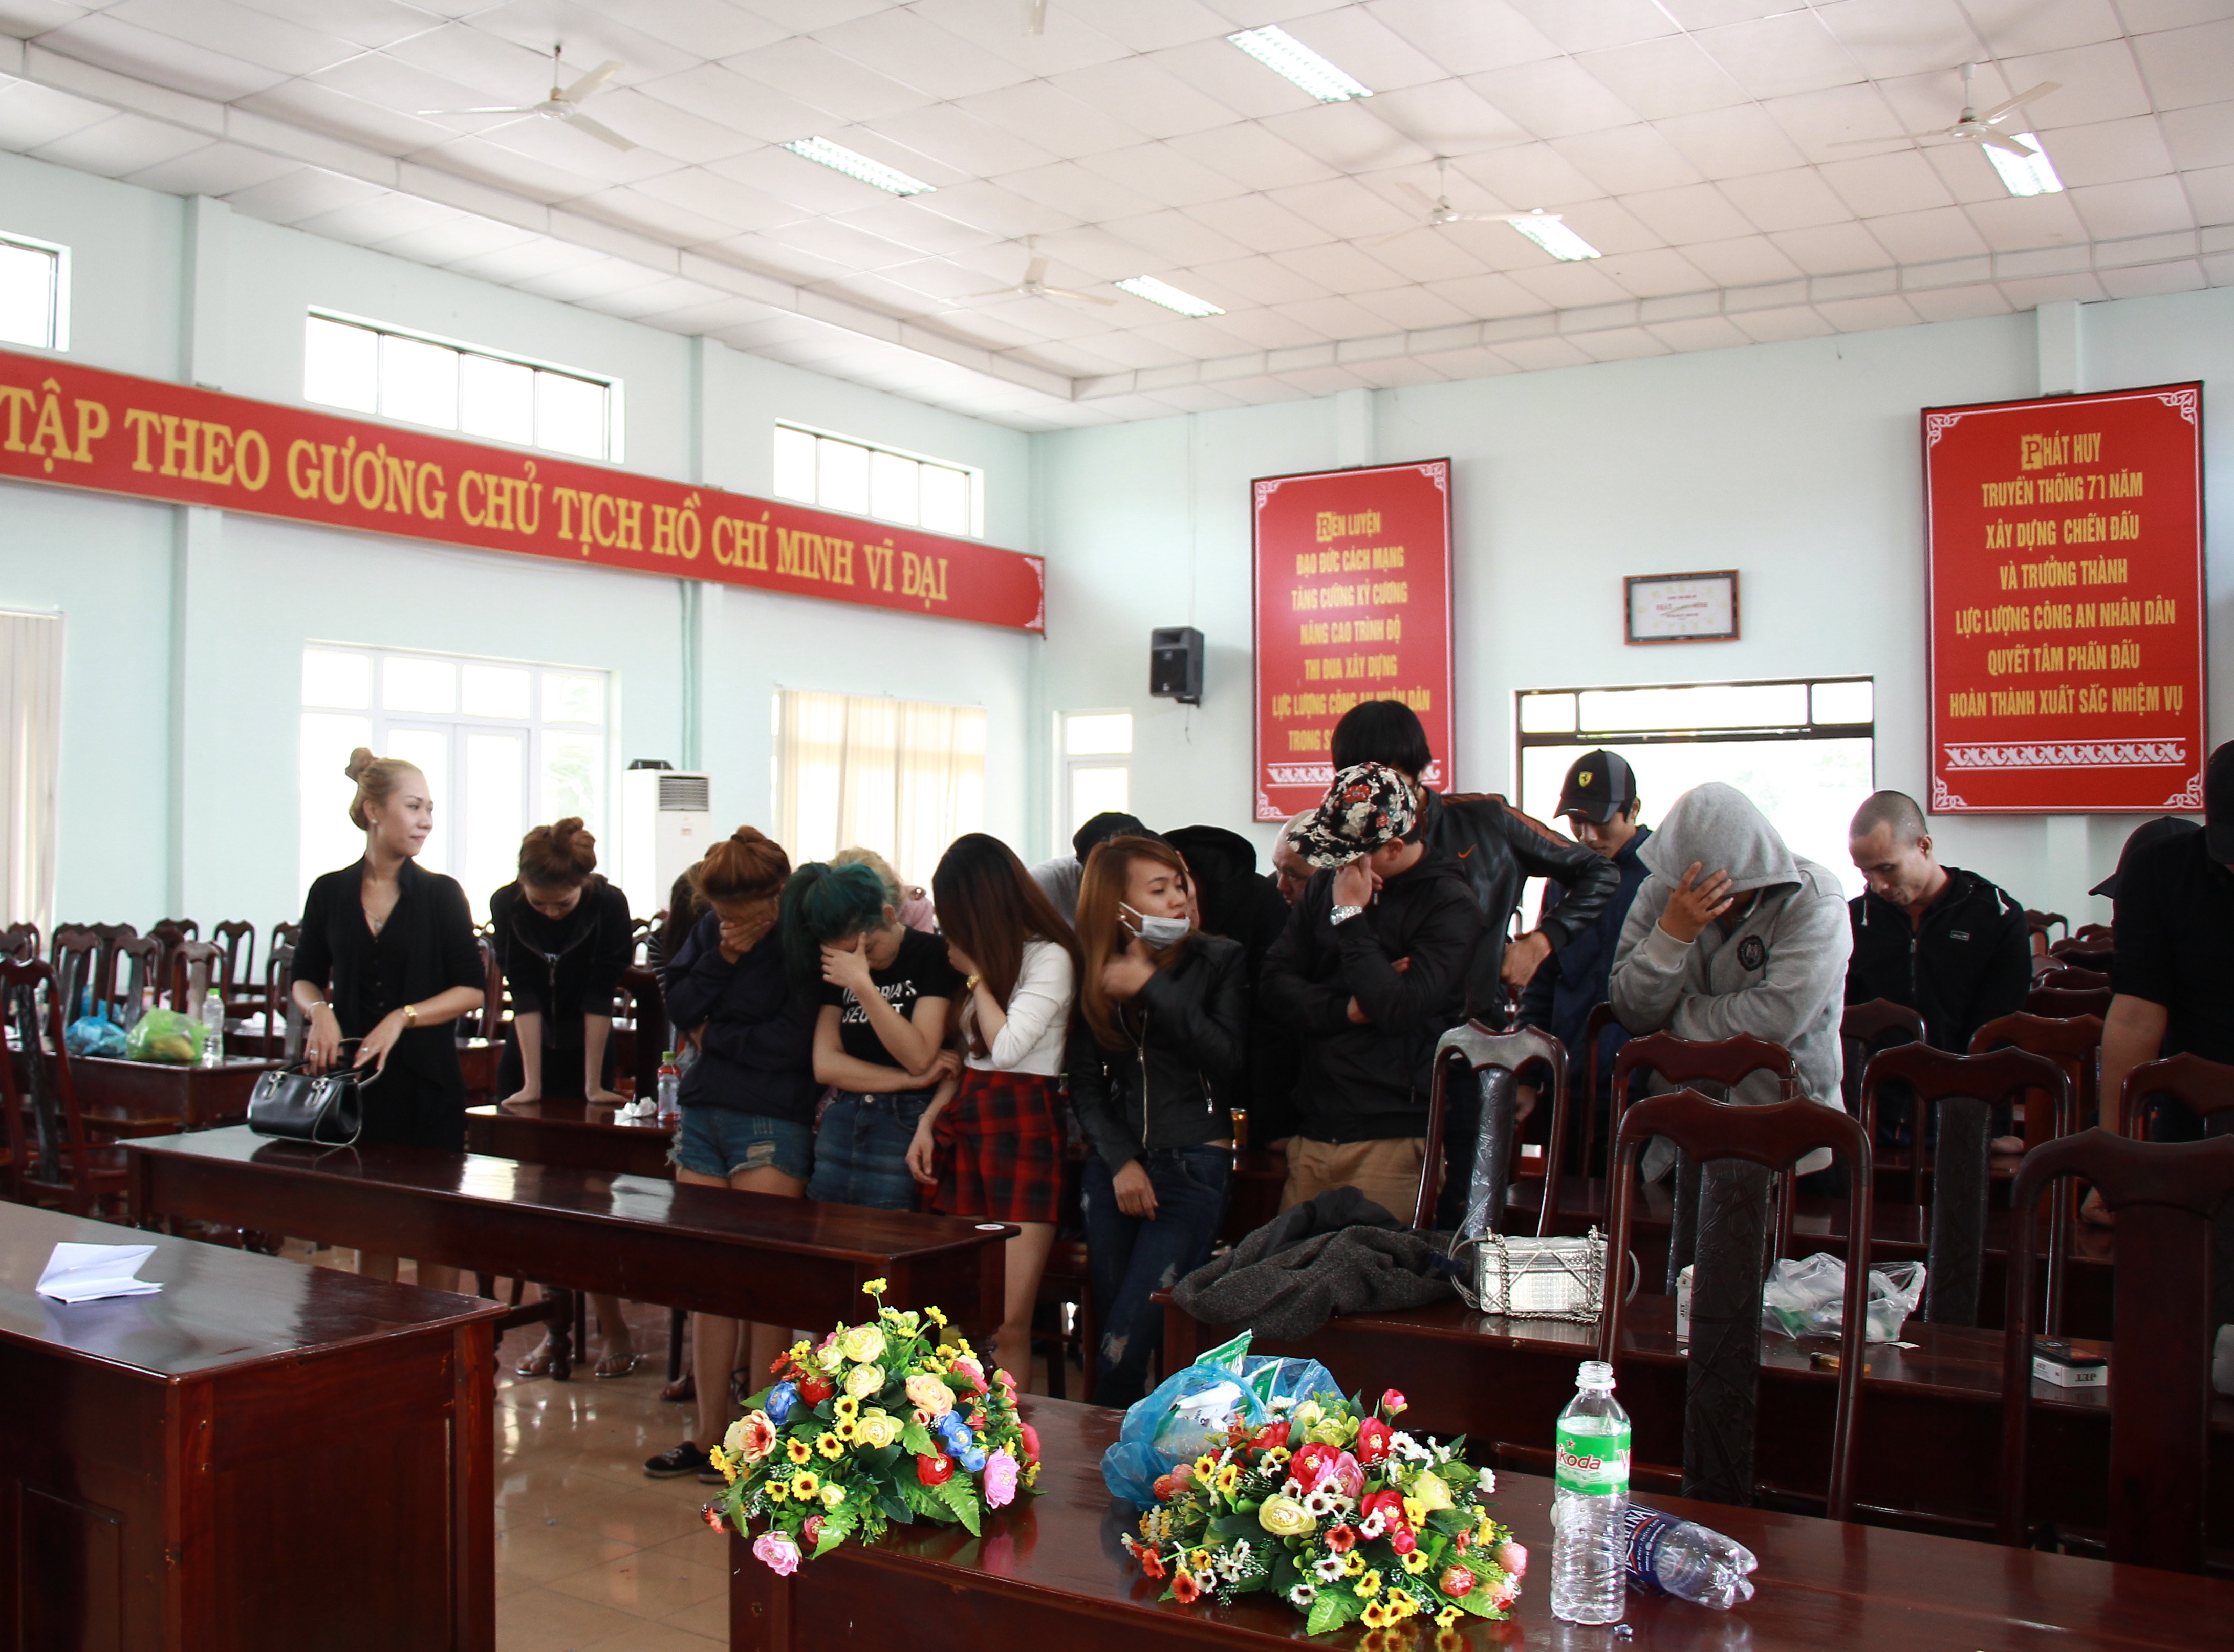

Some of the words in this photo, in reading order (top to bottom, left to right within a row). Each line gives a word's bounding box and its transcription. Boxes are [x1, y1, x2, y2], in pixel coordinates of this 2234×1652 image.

[2021, 430, 2069, 470] PHÁT
[2074, 432, 2101, 463] HUY
[0, 378, 110, 473] TẬP
[124, 408, 270, 491] THEO
[287, 436, 448, 519] GƯƠNG
[458, 461, 543, 534] CHỦ
[553, 487, 644, 555] TỊCH
[651, 492, 702, 559] HỒ
[712, 512, 770, 571] CHÍ
[776, 528, 854, 585] MINH
[864, 539, 894, 591] VĨ
[902, 552, 947, 607] ĐẠI
[1981, 476, 2034, 507] TRUYỀN
[2037, 472, 2084, 503] THỐNG
[2087, 475, 2105, 500] 71
[2109, 468, 2143, 498] NĂM
[1986, 518, 2013, 549] XÂY
[2016, 519, 2056, 551] DỰNG
[2064, 512, 2106, 544] CHIẾN
[2110, 510, 2139, 541] ĐẤU
[2000, 560, 2018, 590] VÀ
[2021, 555, 2077, 588] TRƯỞNG
[2080, 555, 2127, 585] THÀNH
[1956, 607, 1981, 638] LỰC
[1985, 606, 2030, 636] LƯỢNG
[2033, 601, 2072, 630] CÔNG
[2075, 603, 2095, 628] AN
[2100, 597, 2140, 627] NHÂN
[2145, 595, 2175, 625] DÂN
[1988, 644, 2030, 676] QUYẾT
[2033, 643, 2064, 672] TÂM
[2068, 641, 2107, 670] PHẤN
[2111, 639, 2139, 669] ĐẤU
[1950, 688, 1987, 717] HOÀN
[1990, 687, 2035, 716] THÀNH
[2039, 684, 2075, 714] XUẤT
[2079, 684, 2107, 713] SẮC
[2112, 682, 2159, 716] NHIỆM
[2164, 686, 2183, 716] VỤ
[2075, 1372, 2096, 1382] JET
